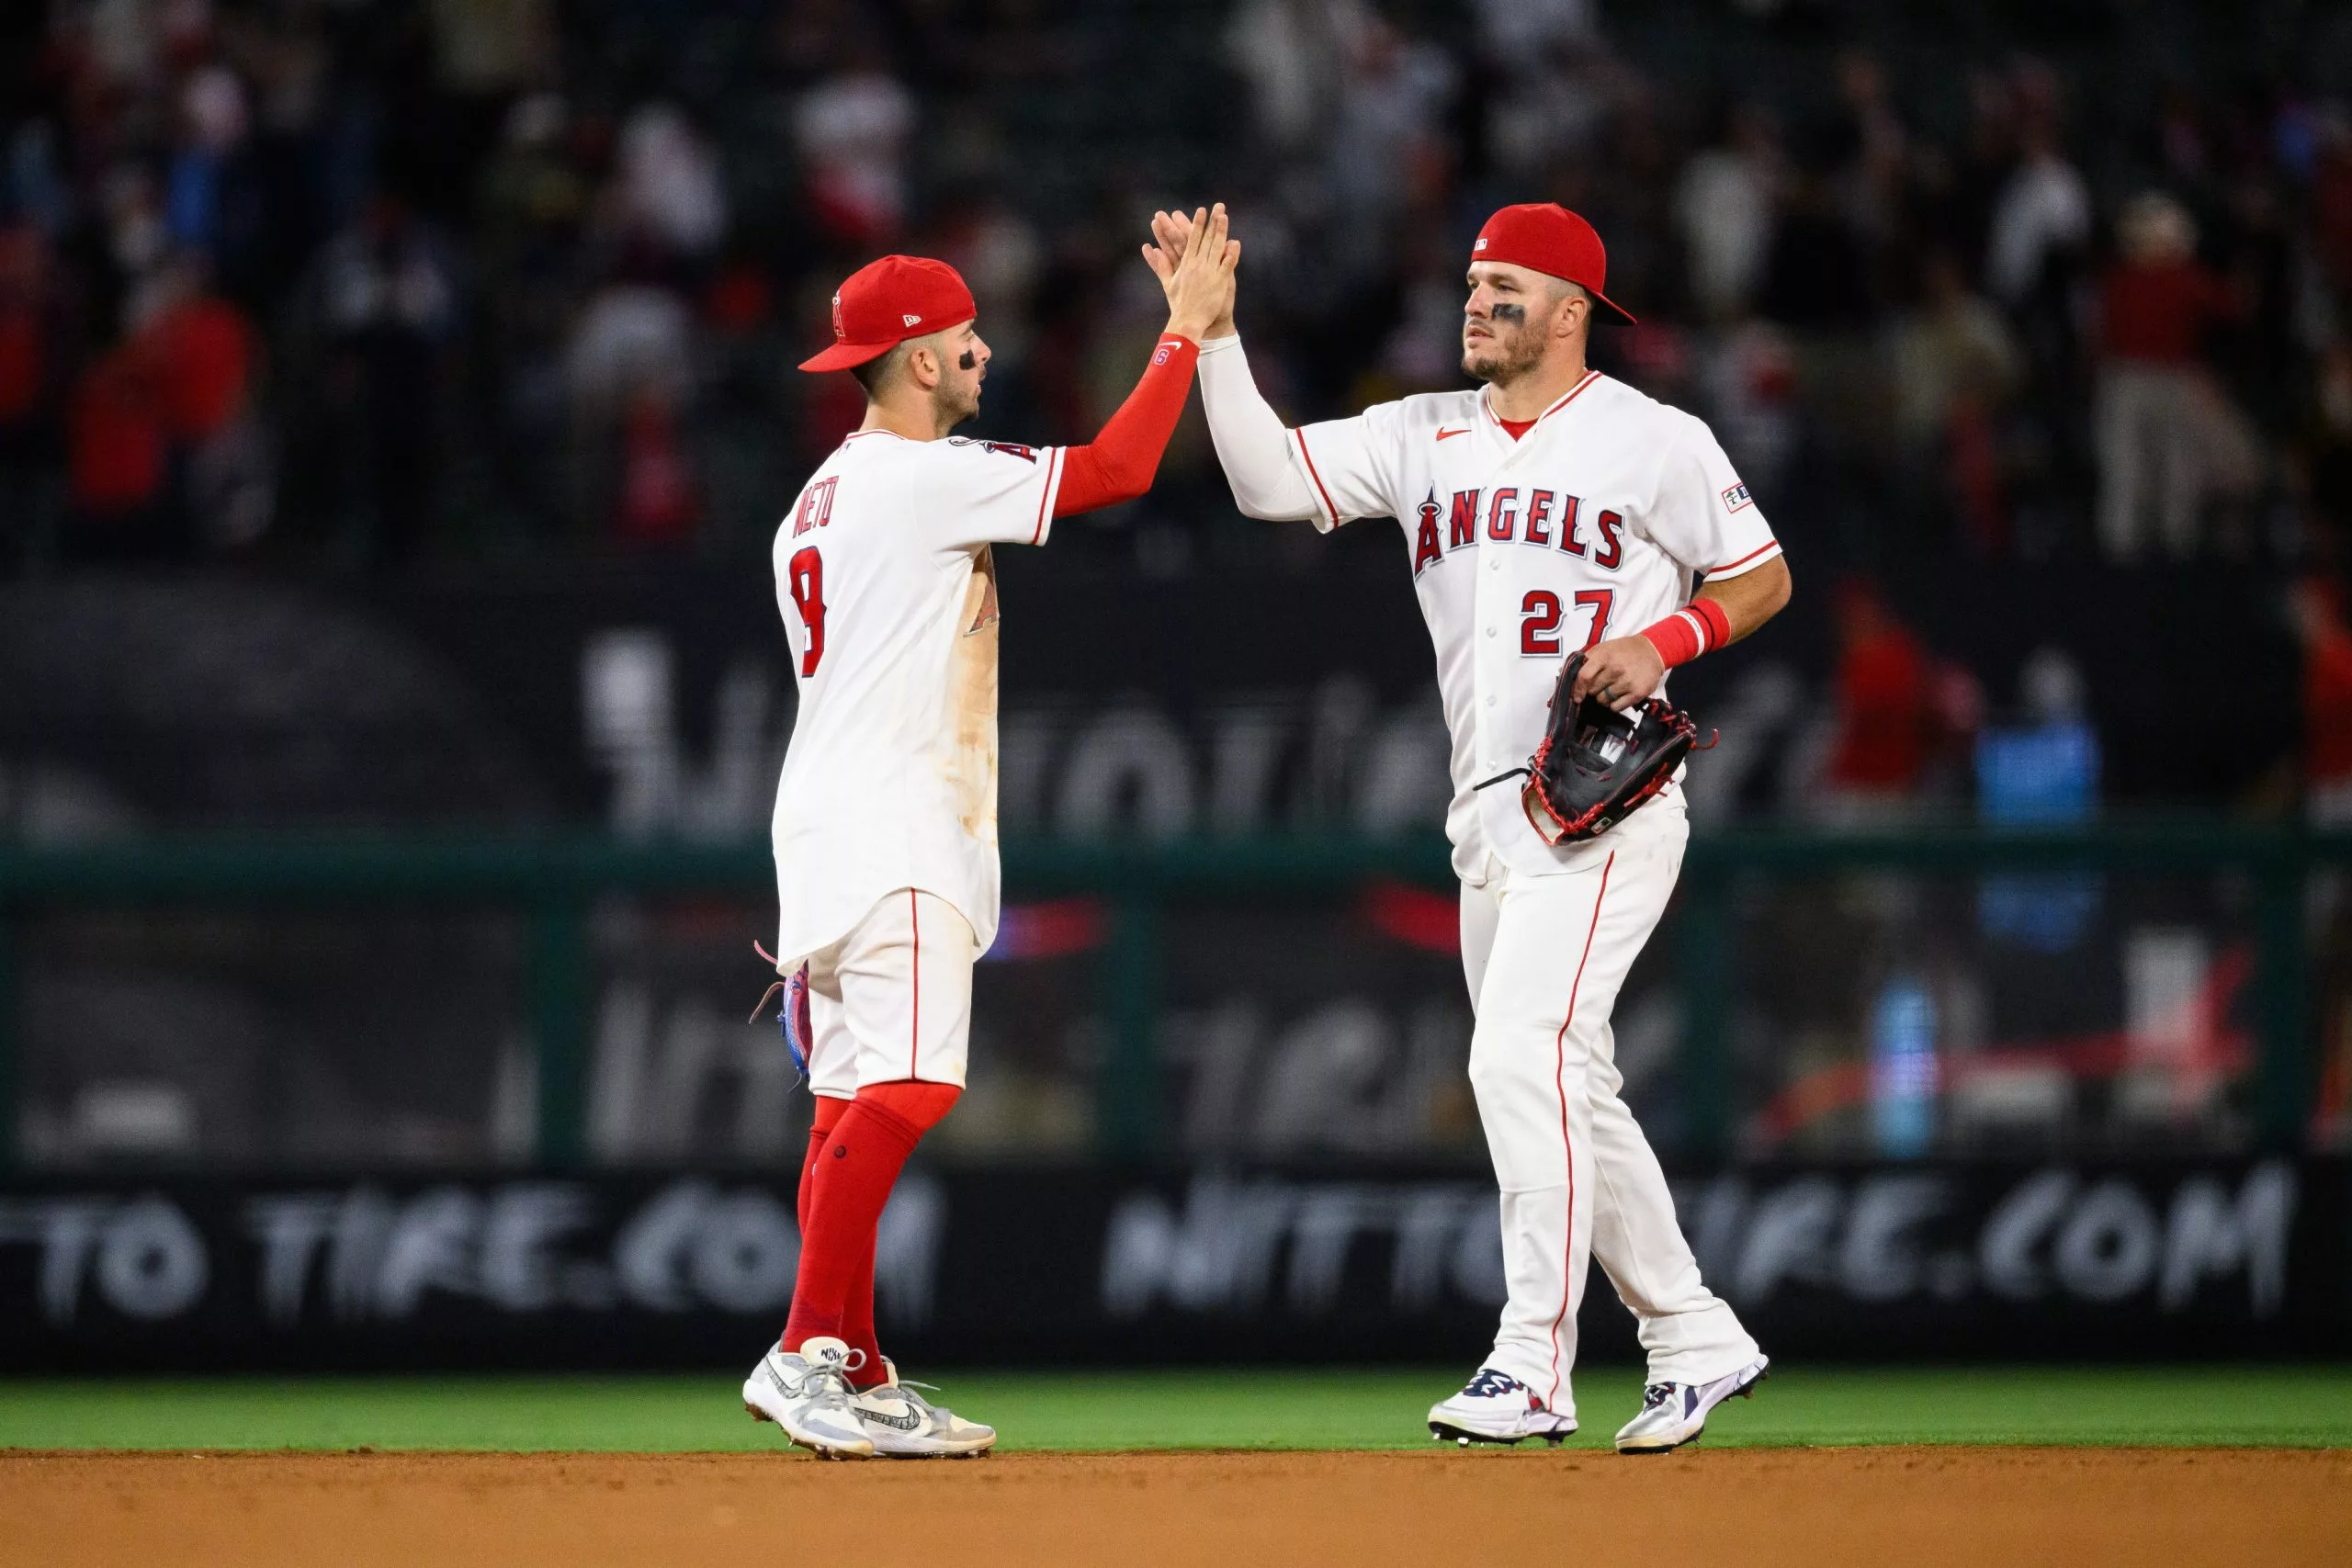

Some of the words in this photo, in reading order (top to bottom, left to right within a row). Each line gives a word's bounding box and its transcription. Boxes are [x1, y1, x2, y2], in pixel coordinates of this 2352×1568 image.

[1154, 348, 1170, 366] 6
[792, 475, 840, 539] NETO
[1414, 479, 1626, 581] ANGELS
[1519, 588, 1616, 659] 27
[0, 1187, 210, 1325] TO
[1683, 1159, 2296, 1314] IRE.COM
